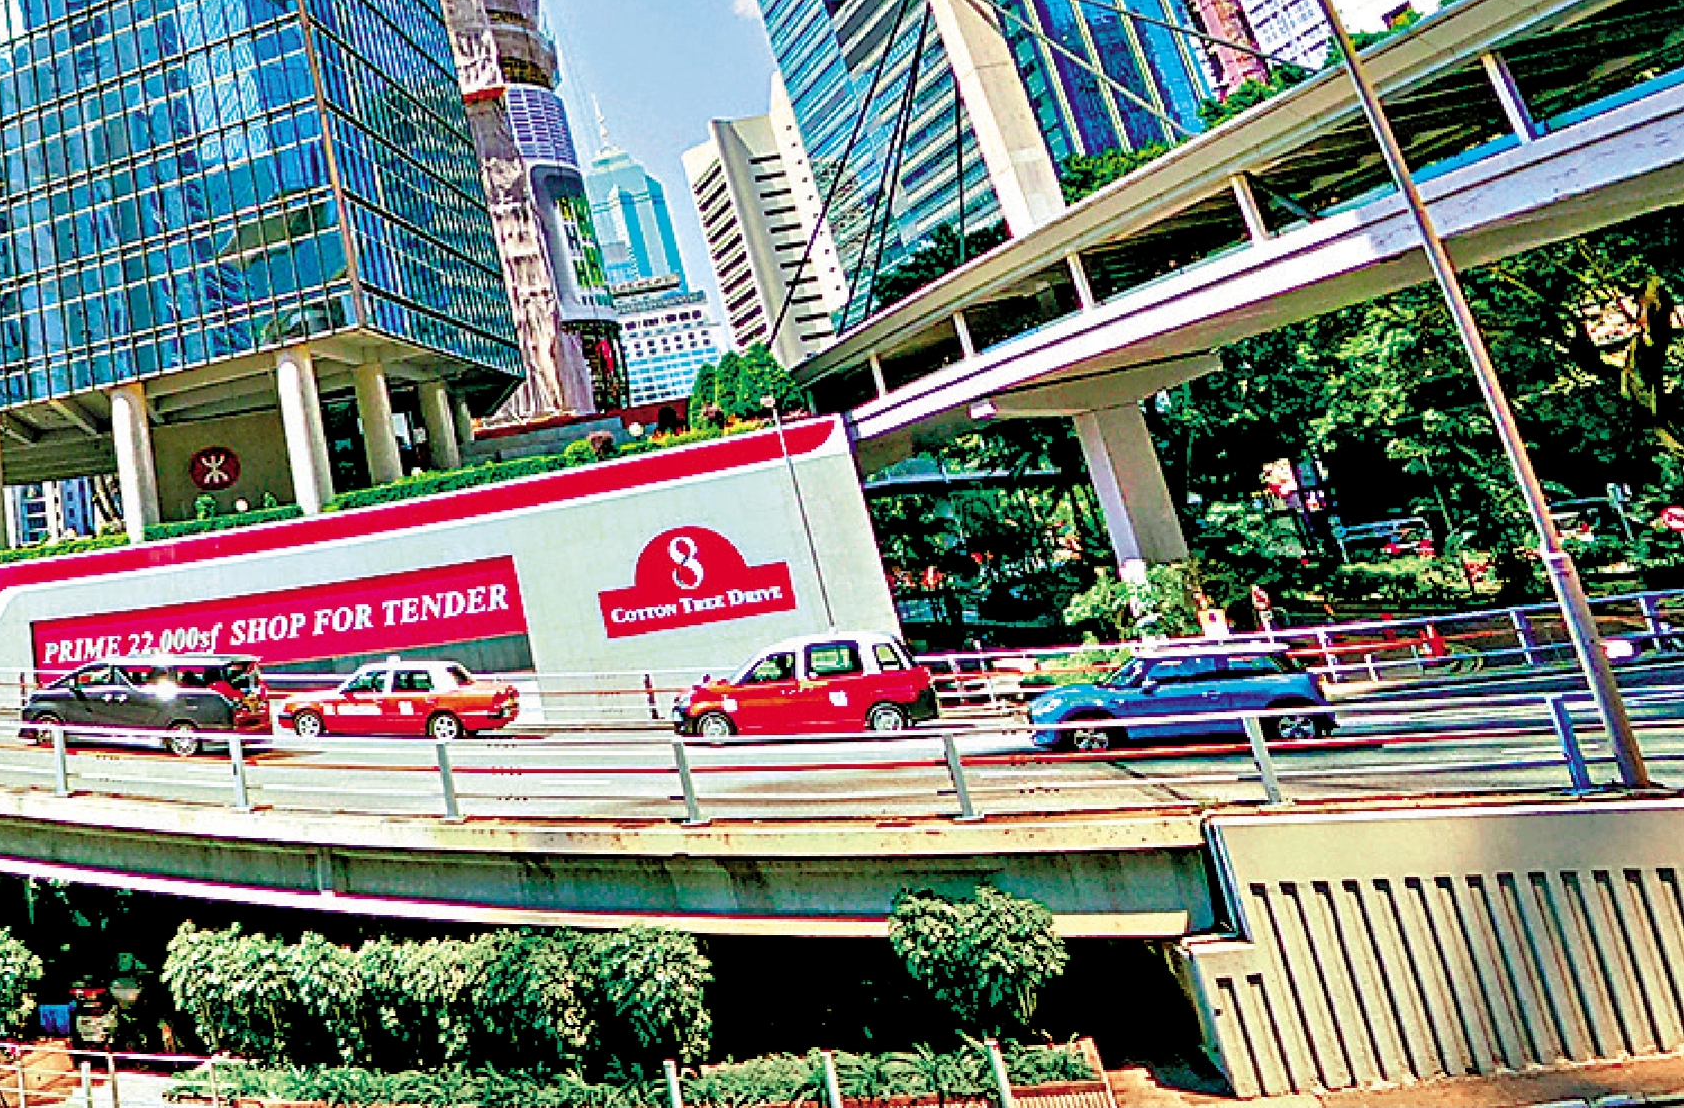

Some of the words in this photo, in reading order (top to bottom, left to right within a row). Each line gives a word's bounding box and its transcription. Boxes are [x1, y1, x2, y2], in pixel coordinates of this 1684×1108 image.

[668, 535, 705, 590] 8
[42, 635, 122, 664] PRIME
[229, 612, 307, 646] SHOP
[312, 603, 374, 637] FOR
[381, 583, 510, 627] TENDER
